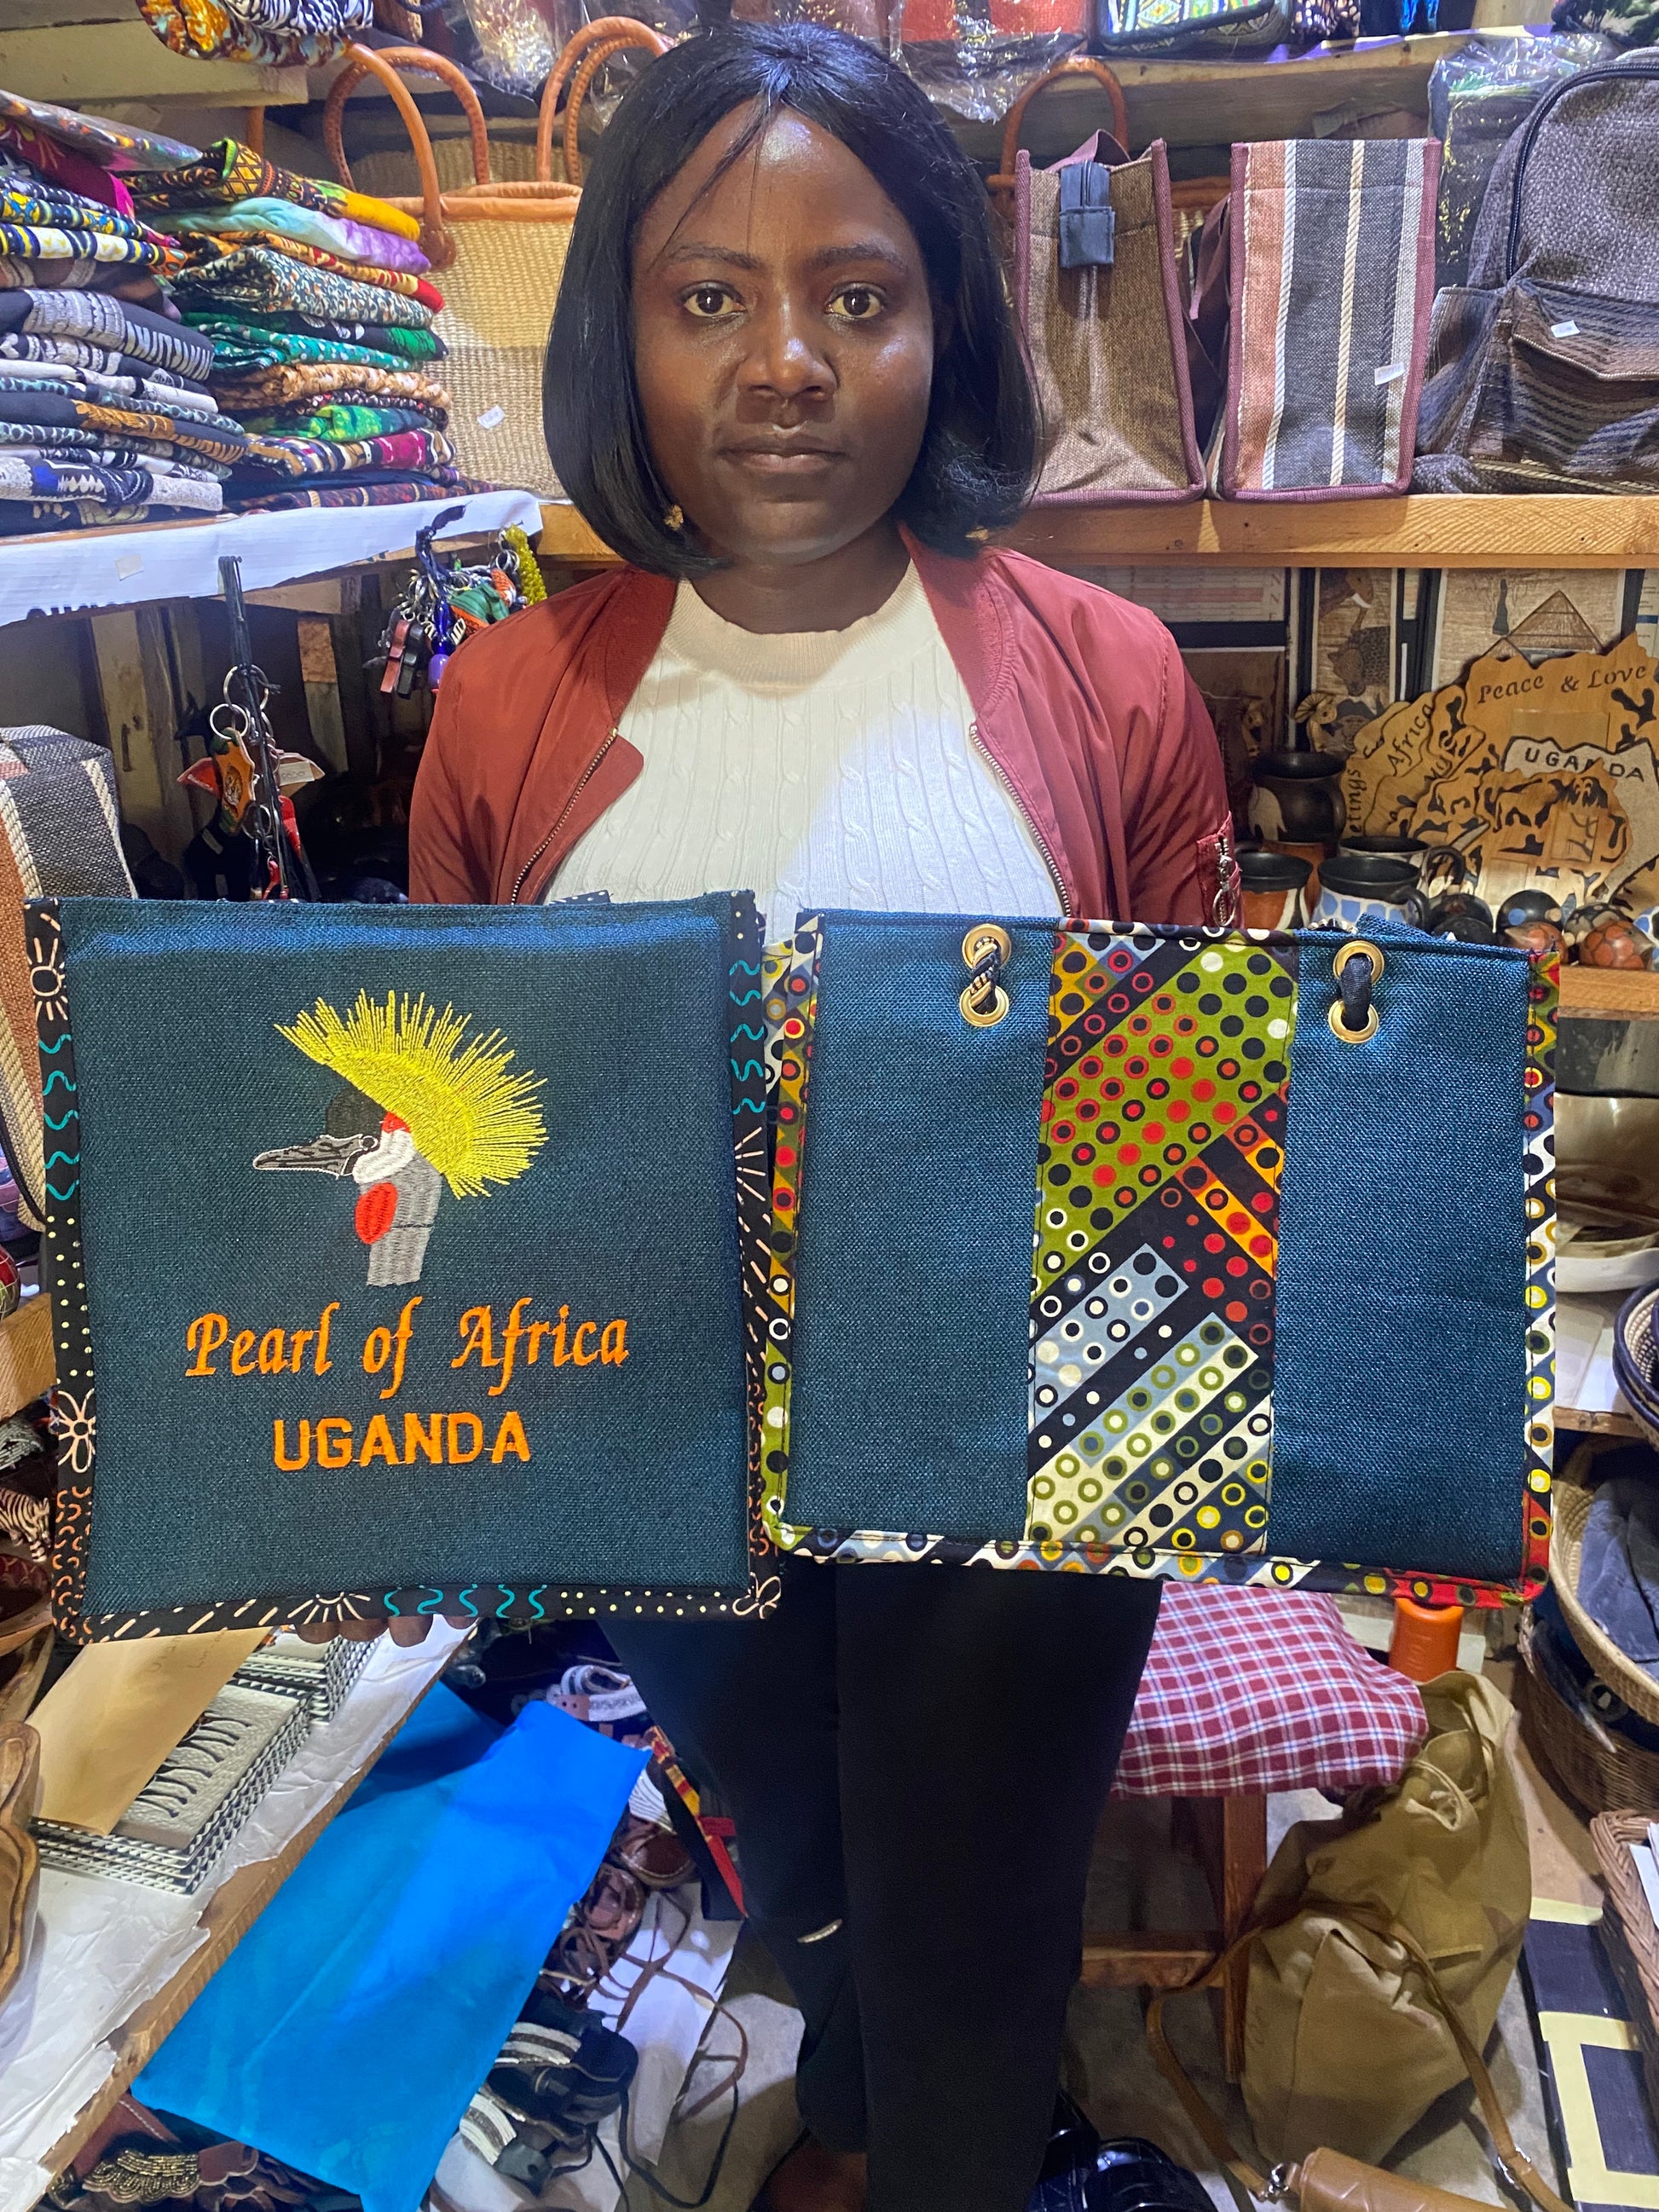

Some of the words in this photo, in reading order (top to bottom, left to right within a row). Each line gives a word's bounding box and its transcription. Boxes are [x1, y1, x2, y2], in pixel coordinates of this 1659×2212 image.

[1477, 675, 1544, 704] Peace
[1560, 675, 1581, 693] &
[1587, 666, 1646, 689] Love
[1347, 768, 1367, 833] etings
[1387, 703, 1434, 777] Africa
[185, 1302, 341, 1377] Pearl
[362, 1296, 423, 1400] of
[450, 1297, 630, 1398] Africa
[273, 1411, 531, 1472] UGANDA
